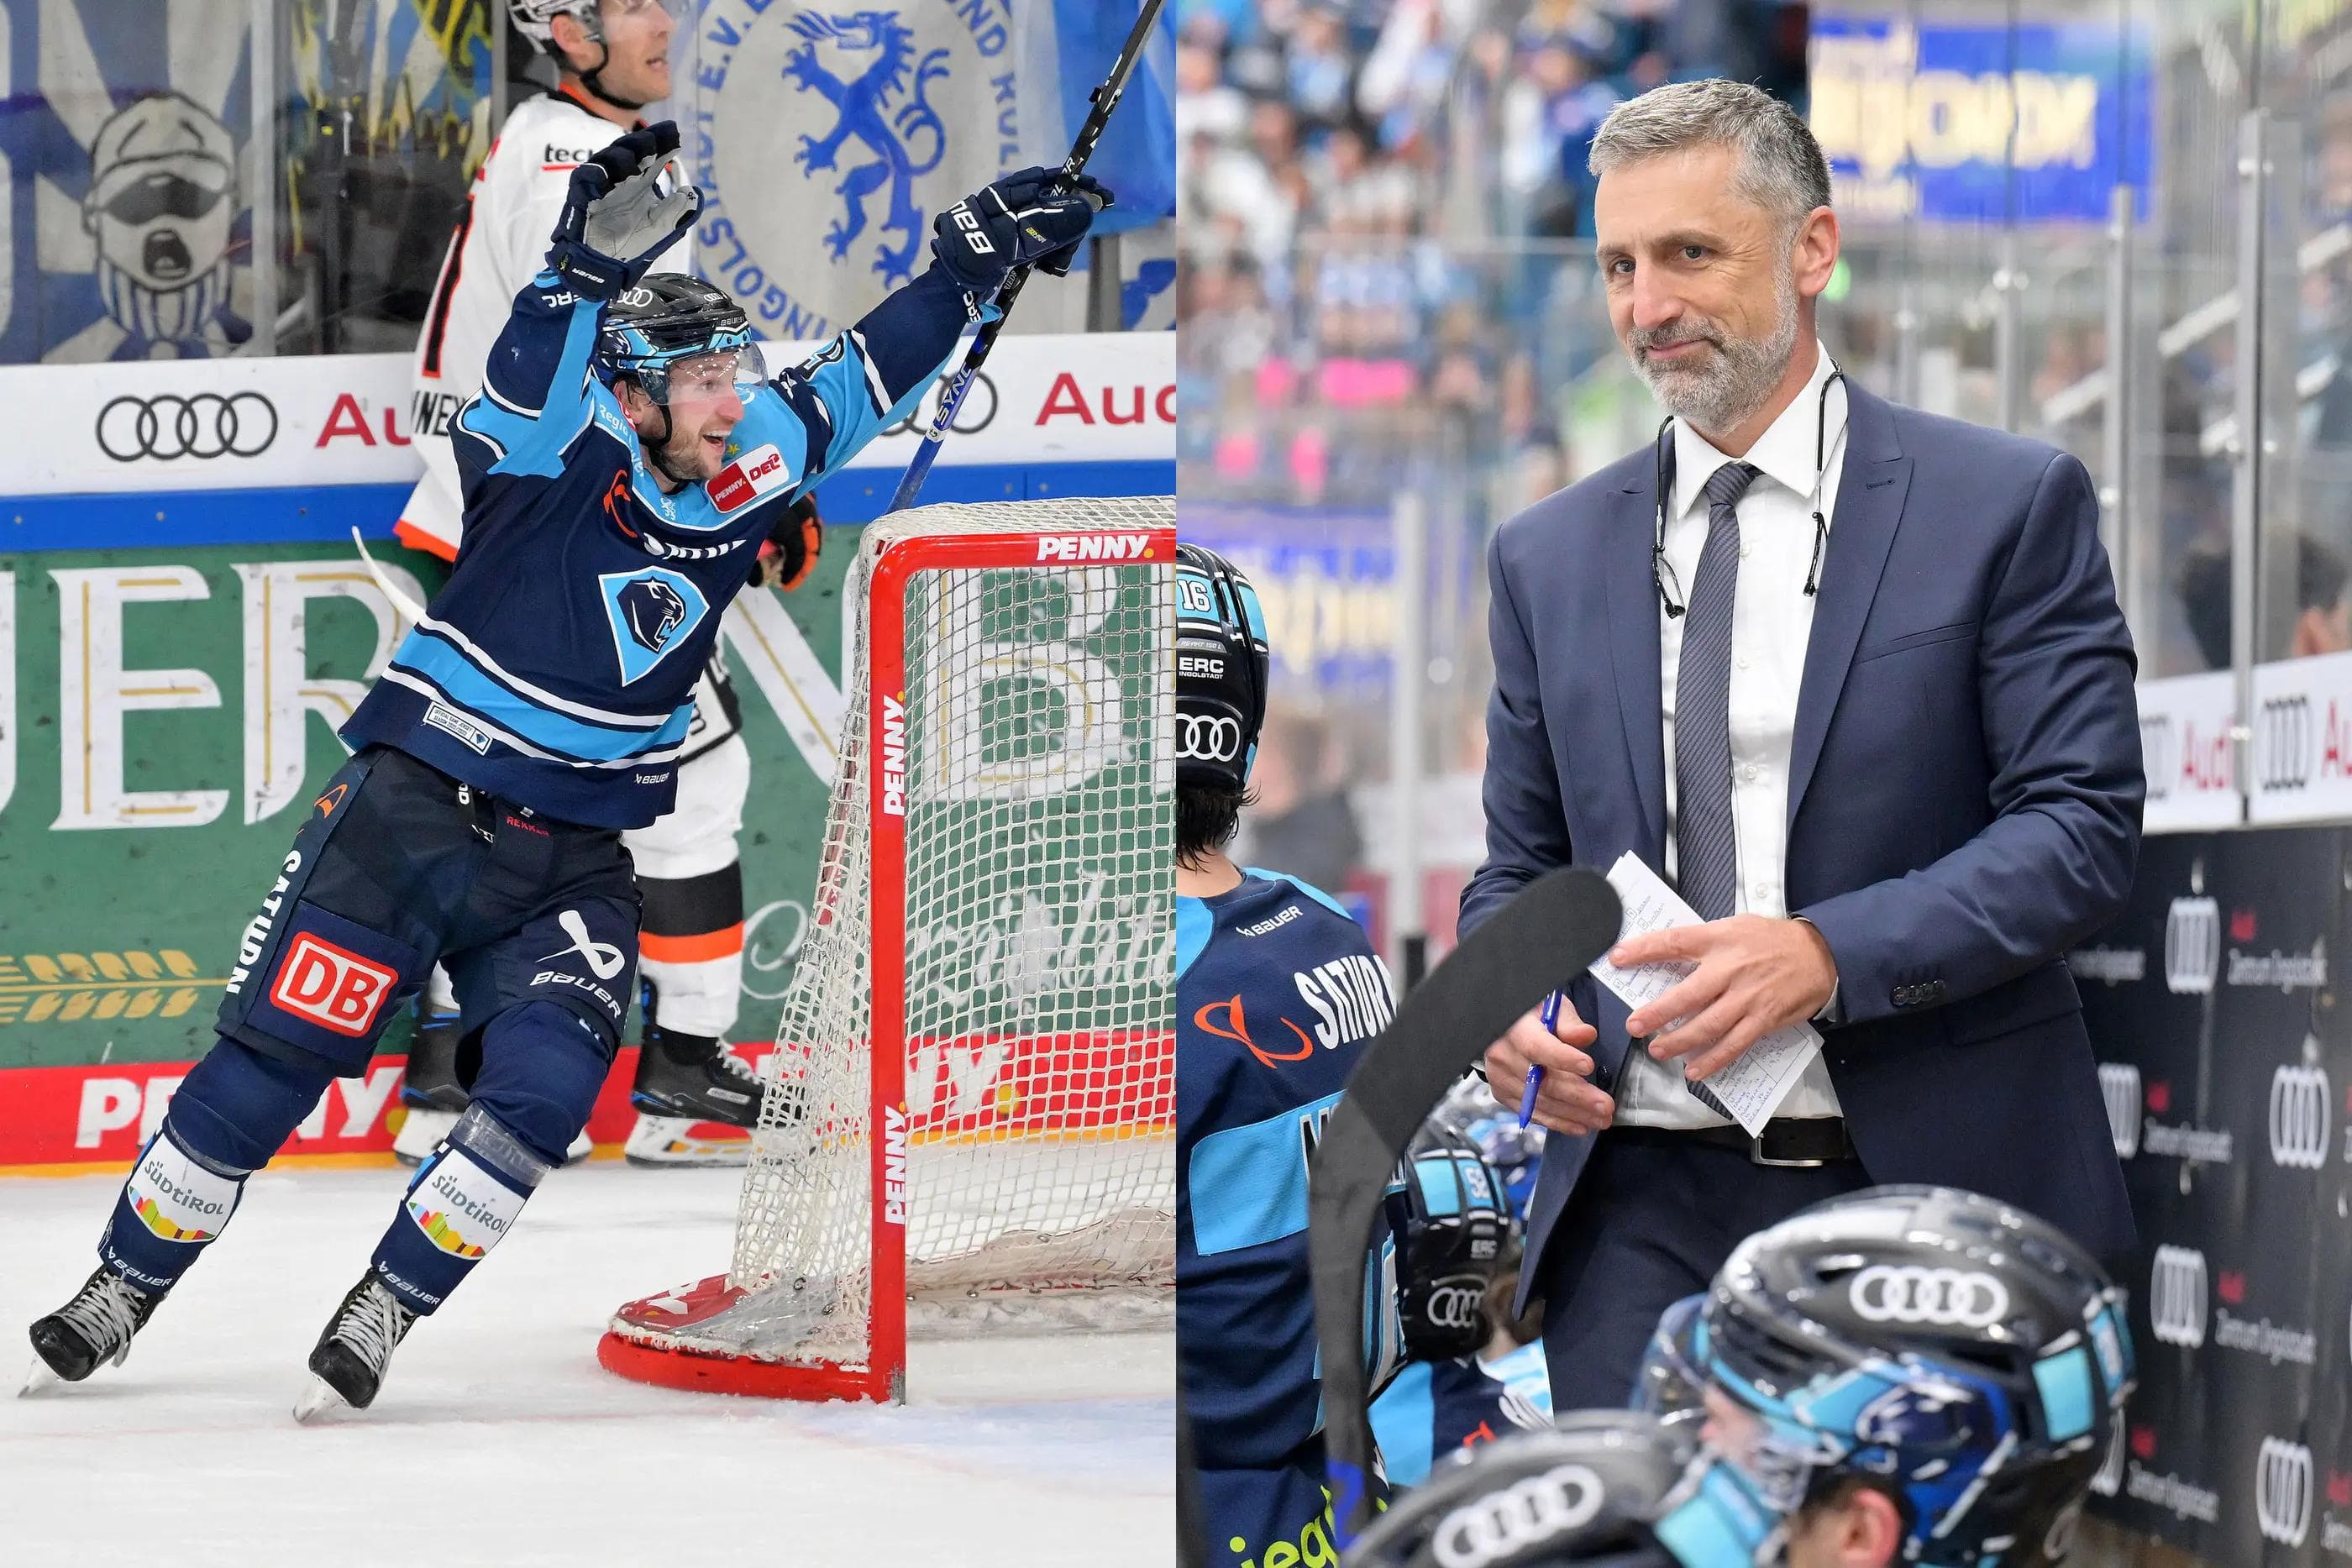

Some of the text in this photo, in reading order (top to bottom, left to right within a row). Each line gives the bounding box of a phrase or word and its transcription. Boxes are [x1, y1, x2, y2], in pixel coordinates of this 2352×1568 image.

[1034, 373, 1176, 425] Au
[315, 394, 412, 448] Au
[1177, 579, 1211, 612] 16
[1179, 657, 1224, 674] ERC
[1179, 671, 1224, 679] INGOLSTADT
[1253, 905, 1303, 936] BAUER
[286, 947, 380, 1023] DB
[529, 971, 622, 1019] BAUER
